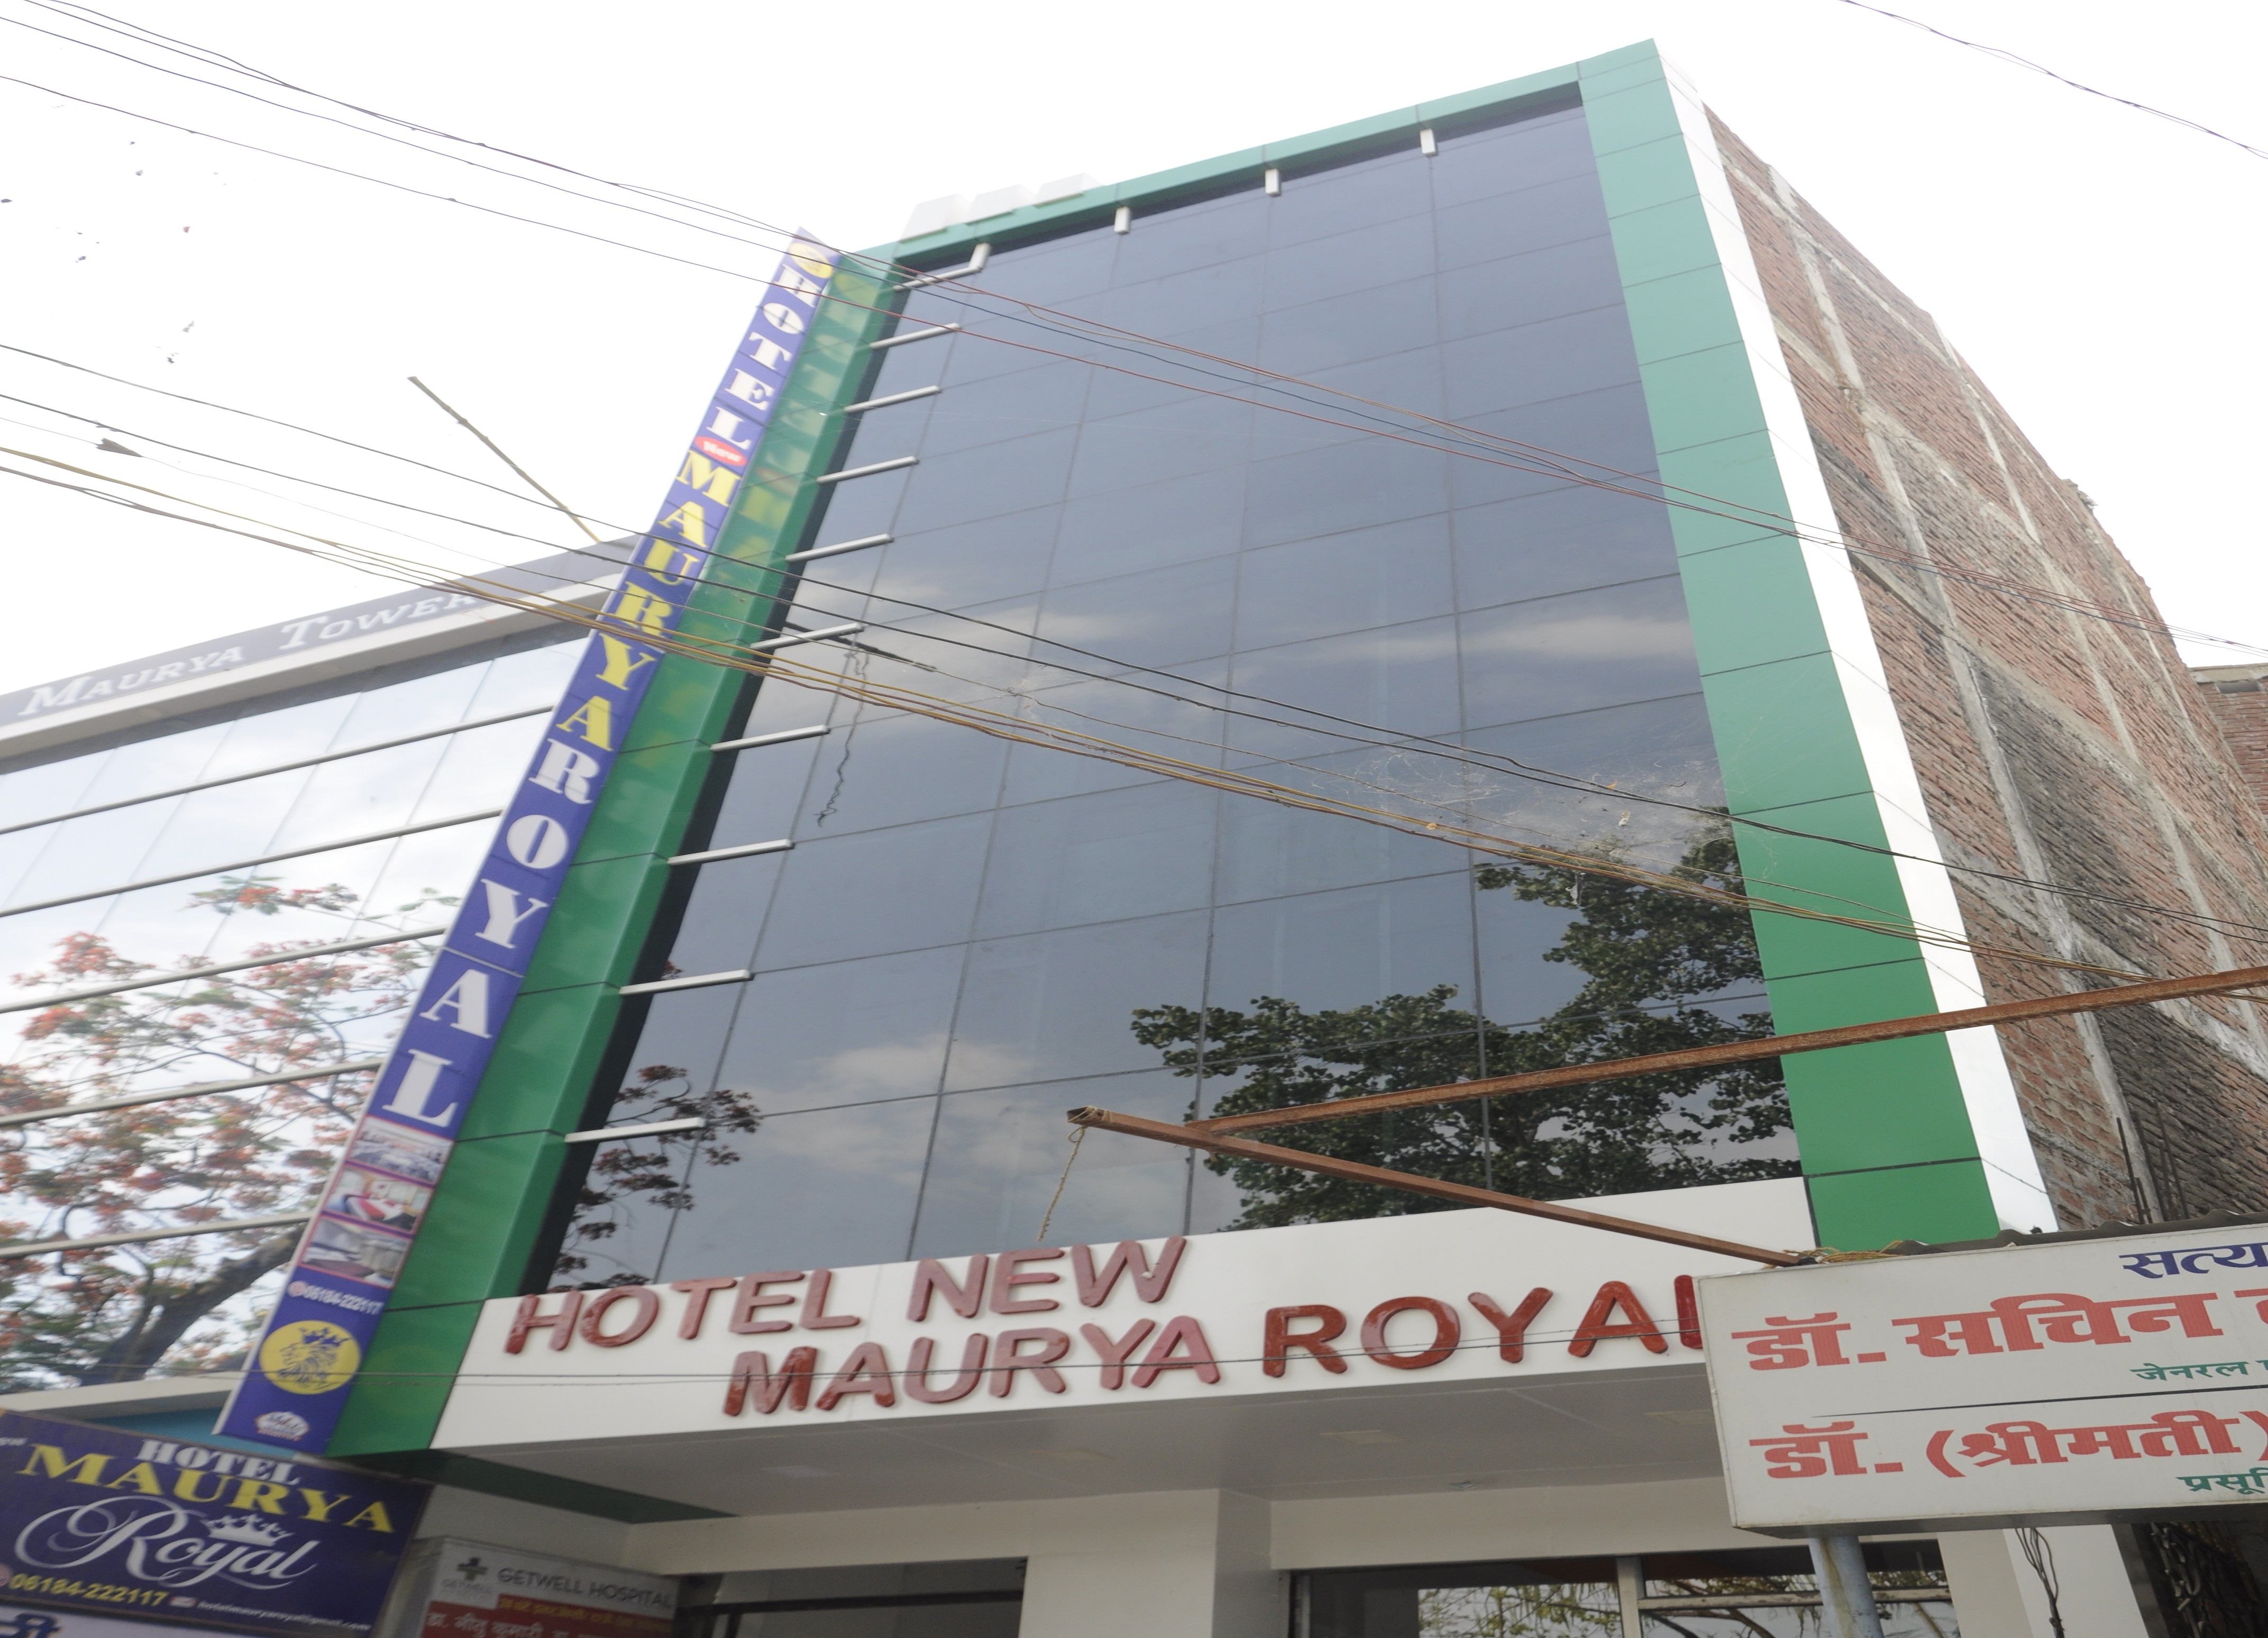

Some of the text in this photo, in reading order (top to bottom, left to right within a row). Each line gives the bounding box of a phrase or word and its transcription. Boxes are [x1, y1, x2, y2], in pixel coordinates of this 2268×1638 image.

[706, 263, 823, 450] HOTEL
[558, 450, 743, 751] MAURYA
[382, 738, 600, 1128] ROYAL
[504, 1235, 1187, 1355] HOTEL NEW
[1732, 1312, 1887, 1371] डॉ.
[1892, 1293, 2224, 1358] सचिन
[723, 1314, 1221, 1417] MAURYA
[2129, 1362, 2251, 1381] जेनरल
[15, 1443, 394, 1533] MAURYA
[135, 1439, 302, 1486] HOTEL
[1749, 1421, 1904, 1479] डॉ.
[14, 1495, 321, 1589] Royal
[8, 1573, 169, 1607] 06184-222117
[497, 1568, 583, 1595] GETWELL
[589, 1581, 674, 1609] HOSPITAL
